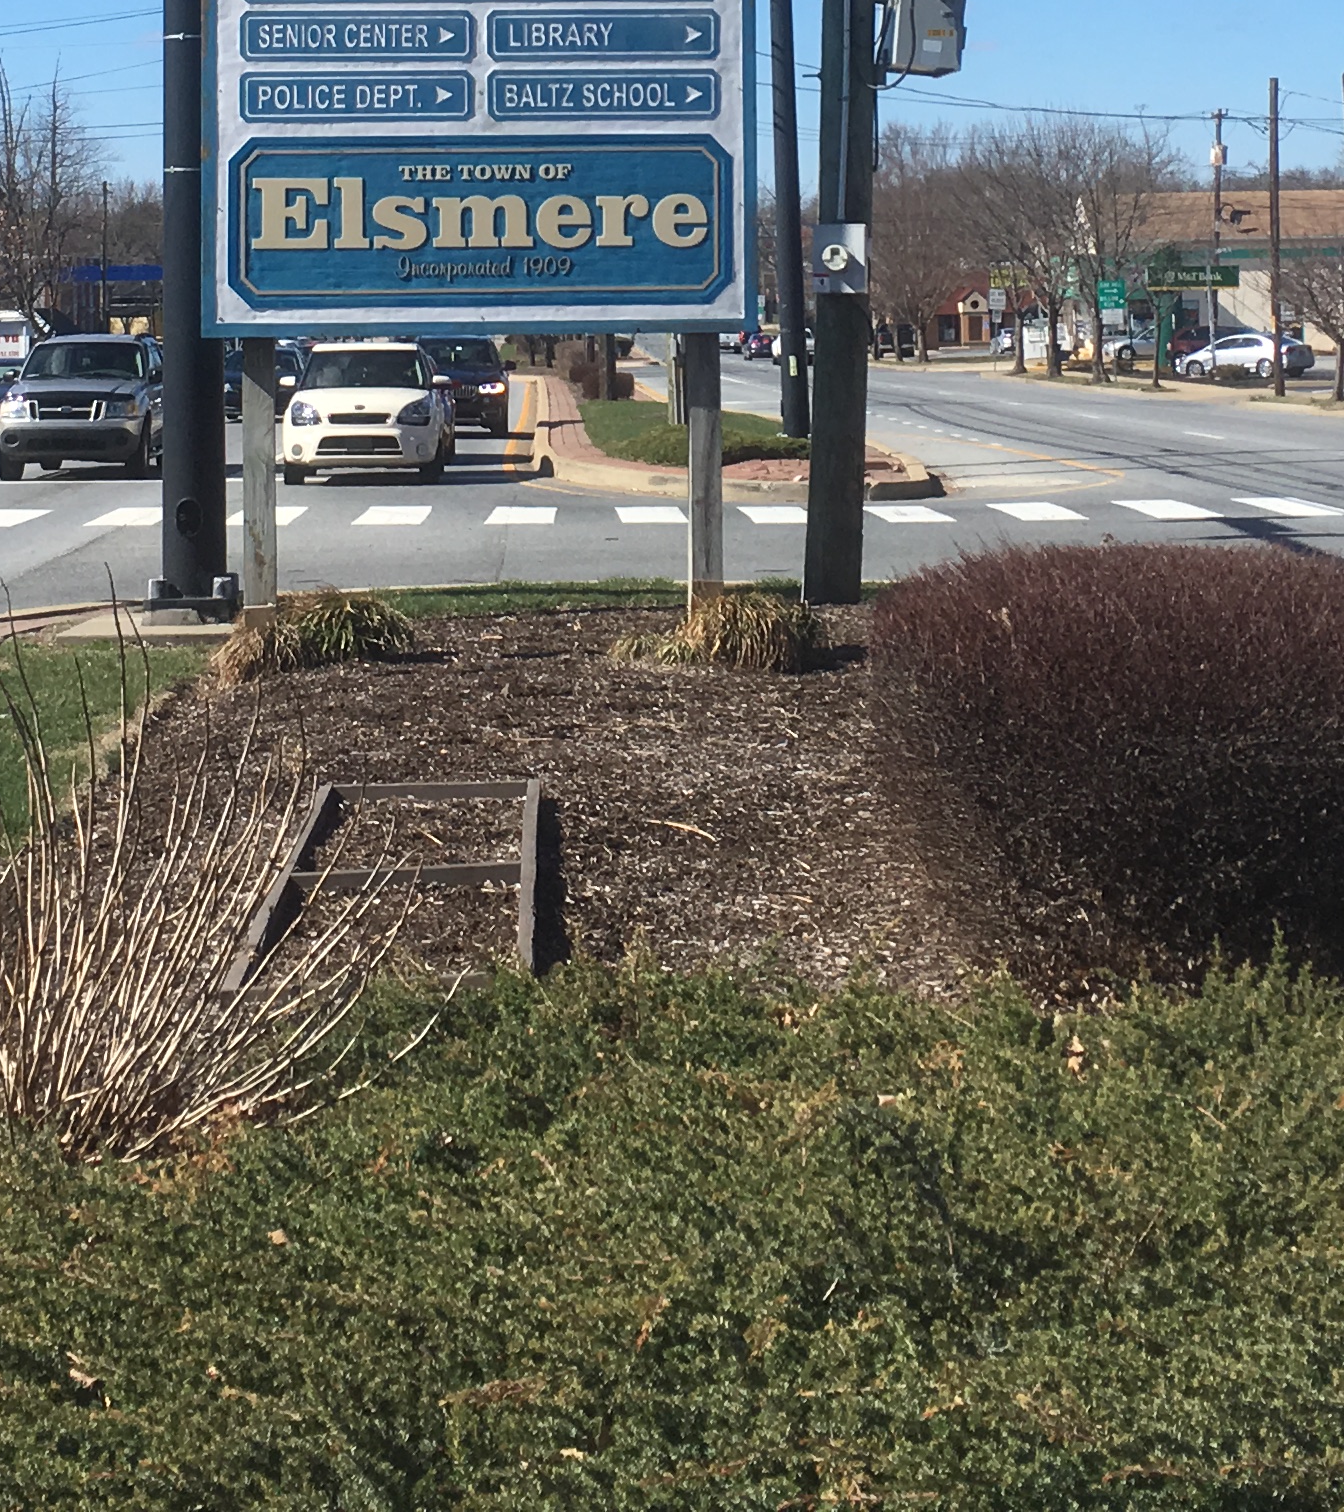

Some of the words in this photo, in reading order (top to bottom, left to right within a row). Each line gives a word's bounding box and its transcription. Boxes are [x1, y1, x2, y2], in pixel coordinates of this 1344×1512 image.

[258, 23, 338, 49] SENIOR
[344, 23, 430, 49] CENTER
[508, 21, 614, 48] LIBRARY
[257, 85, 347, 110] POLICE
[355, 84, 423, 109] DEPT.
[505, 83, 575, 108] BALTZ
[581, 82, 677, 107] SCHOOL
[399, 164, 452, 181] THE
[458, 163, 533, 181] TOWN
[538, 163, 572, 180] OF
[251, 177, 709, 251] Elsmere
[396, 255, 512, 282] Incorporated
[522, 255, 572, 277] 1909
